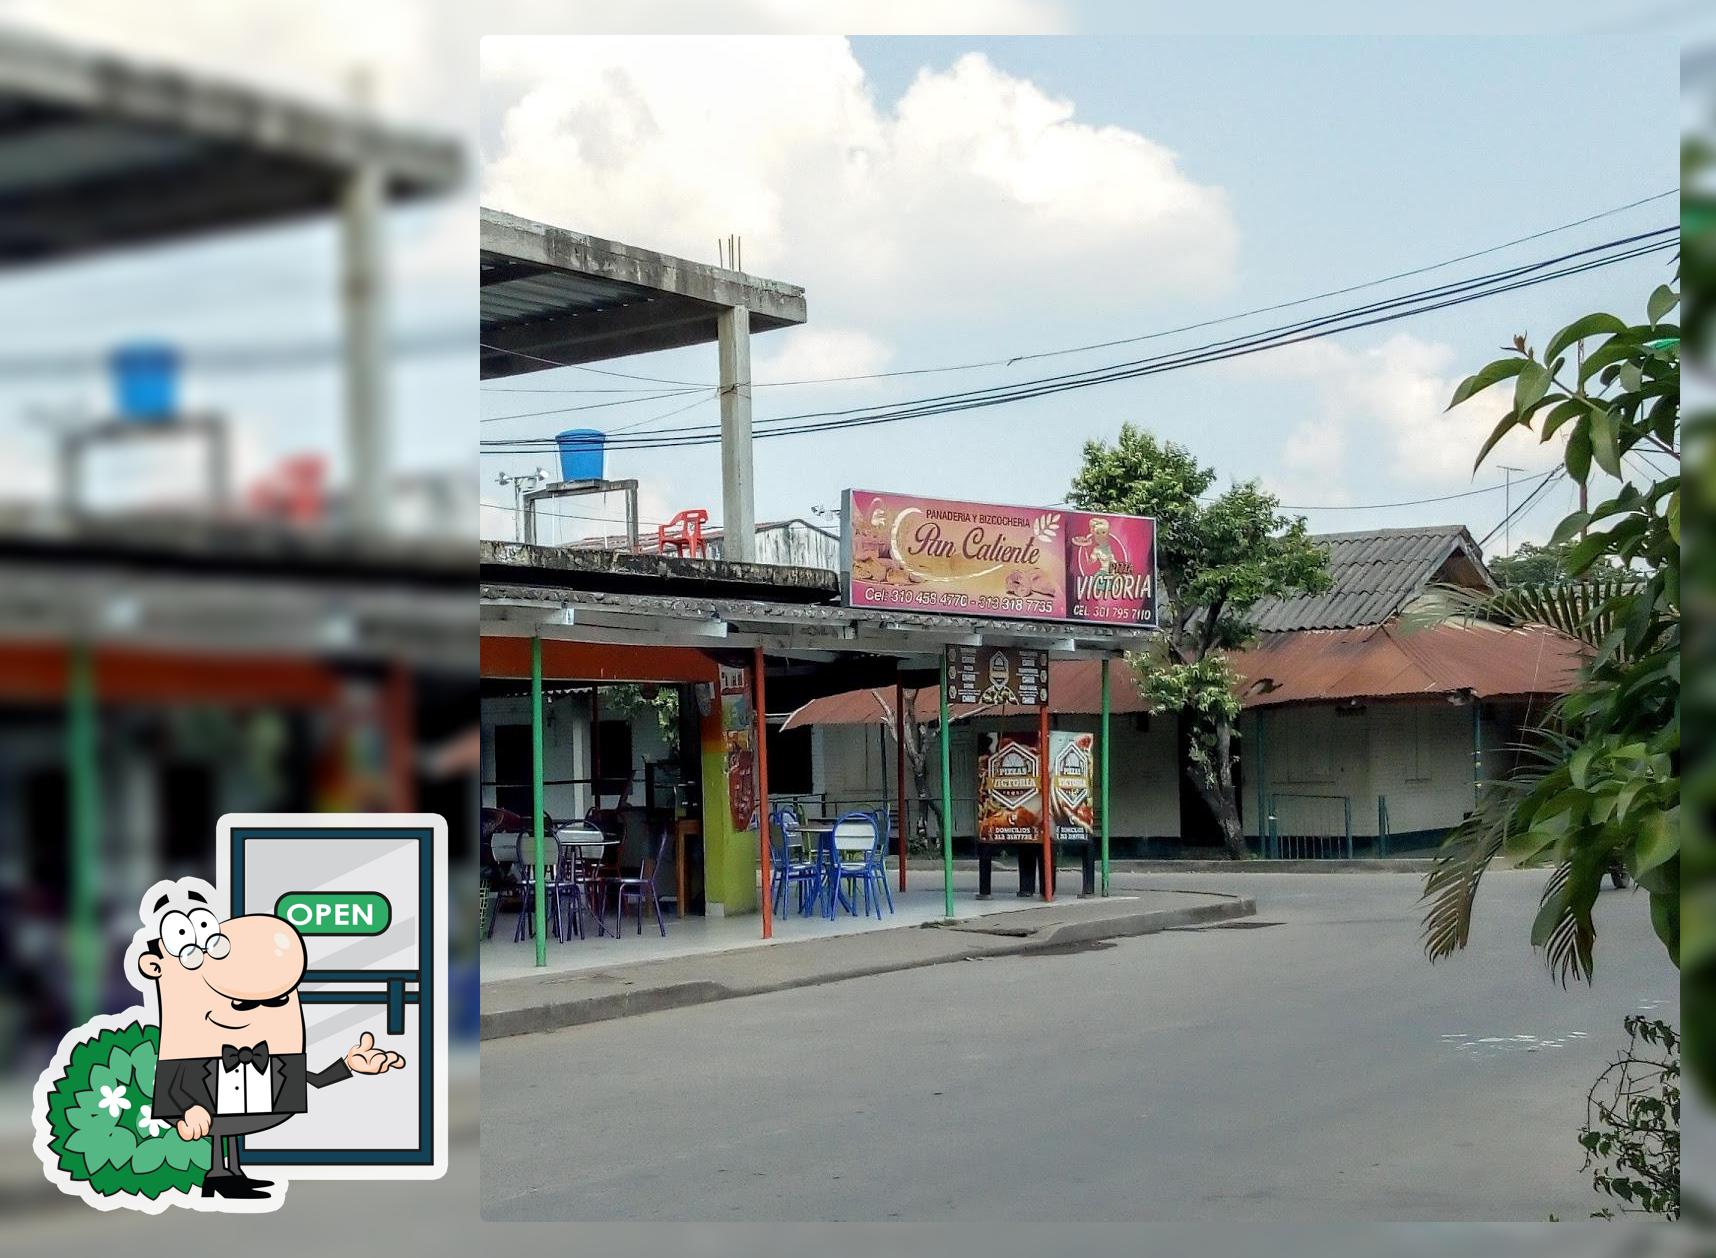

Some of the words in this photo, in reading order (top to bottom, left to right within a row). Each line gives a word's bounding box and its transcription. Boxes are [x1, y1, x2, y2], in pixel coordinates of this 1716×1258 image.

[972, 514, 978, 522] Y
[907, 522, 956, 558] Pan
[962, 526, 1041, 565] Caliente
[1076, 574, 1152, 601] VICTORIA
[865, 587, 888, 602] Cel:
[891, 589, 913, 604] 310
[915, 591, 937, 605] 458
[939, 593, 968, 608] 4770
[1002, 597, 1023, 611] 318
[1026, 599, 1053, 613] 7735
[1093, 606, 1109, 618] 301
[1112, 607, 1129, 619] 795
[1131, 608, 1151, 620] 7110
[992, 778, 1036, 788] VICTORIA
